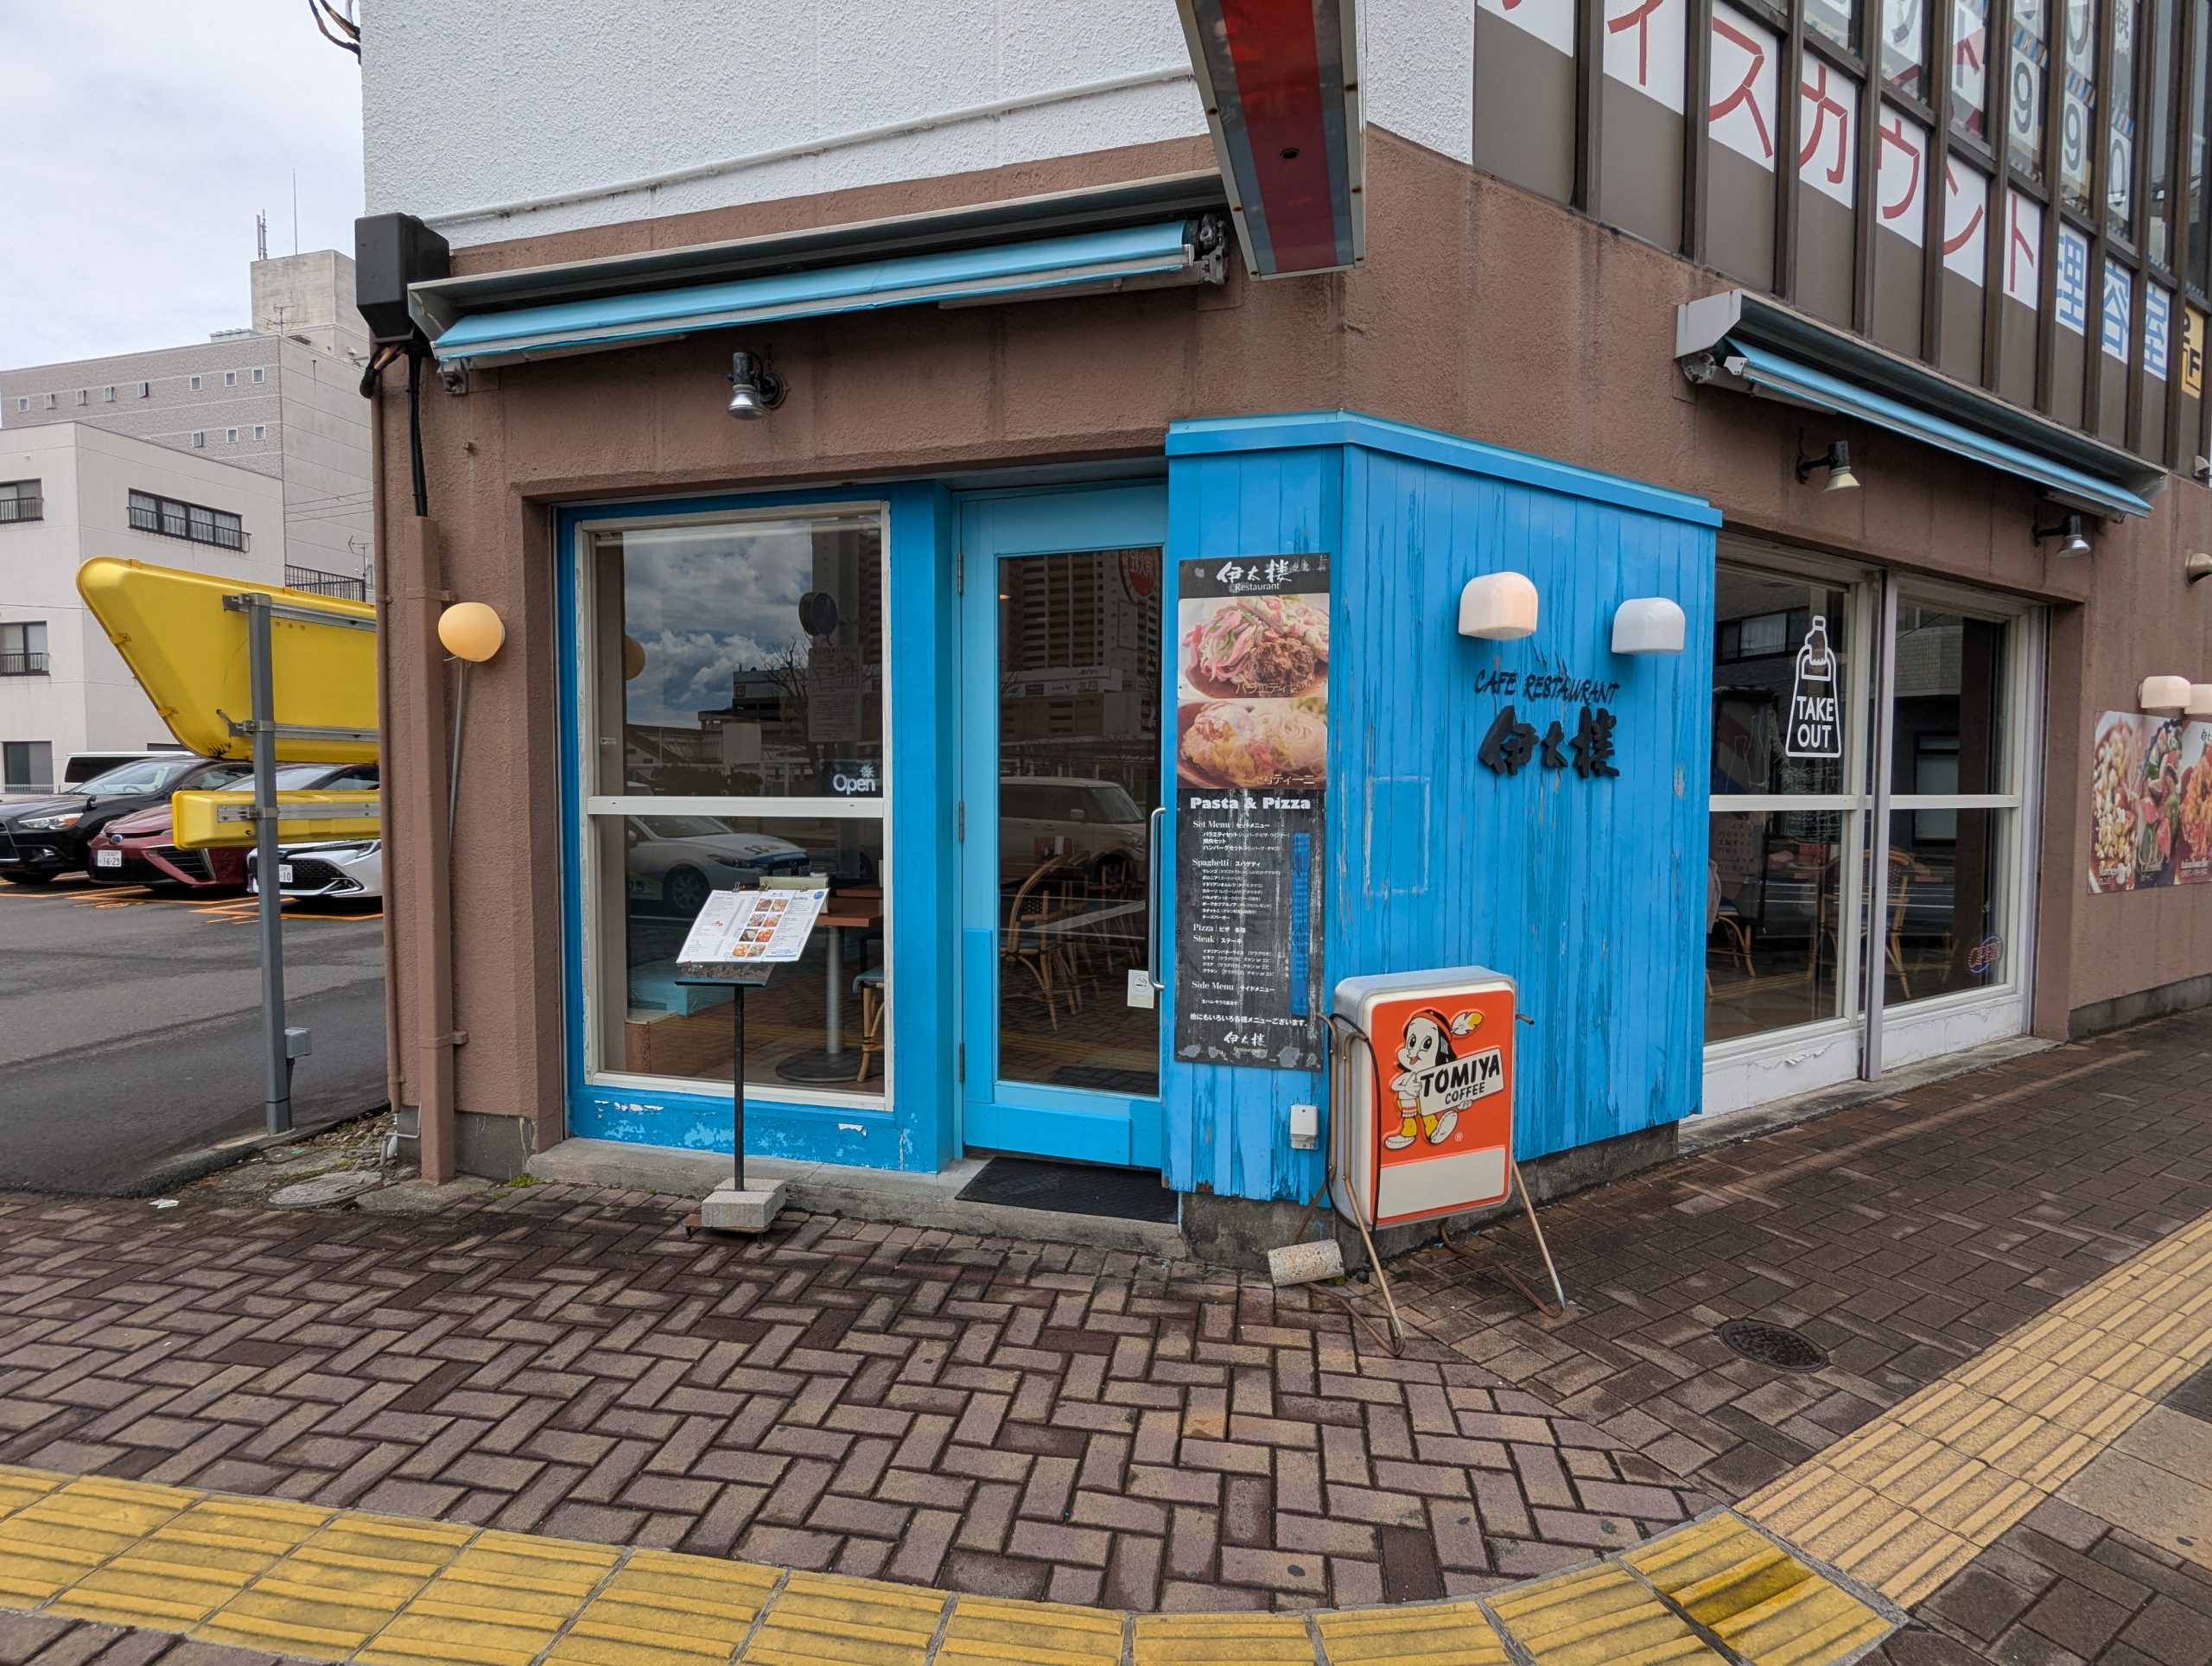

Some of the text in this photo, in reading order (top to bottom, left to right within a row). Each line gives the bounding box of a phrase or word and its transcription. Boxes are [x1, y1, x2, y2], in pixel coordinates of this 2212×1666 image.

[1235, 582, 1280, 592] Restaurant
[1522, 673, 1620, 705] RESTAURANT
[1796, 695, 1834, 722] TAKE
[1797, 725, 1833, 748] OUT
[832, 773, 876, 795] Open
[1190, 797, 1311, 810] Pasta & Pizza
[1192, 820, 1206, 829] Set
[1192, 858, 1230, 868] Spaghetti
[1192, 923, 1214, 932] Pizza
[1192, 934, 1215, 944] Steak
[1192, 981, 1210, 989] Side
[1211, 982, 1234, 991] Menu
[1420, 1053, 1500, 1097] TOMIYA
[1445, 1080, 1485, 1105] COFFEE
